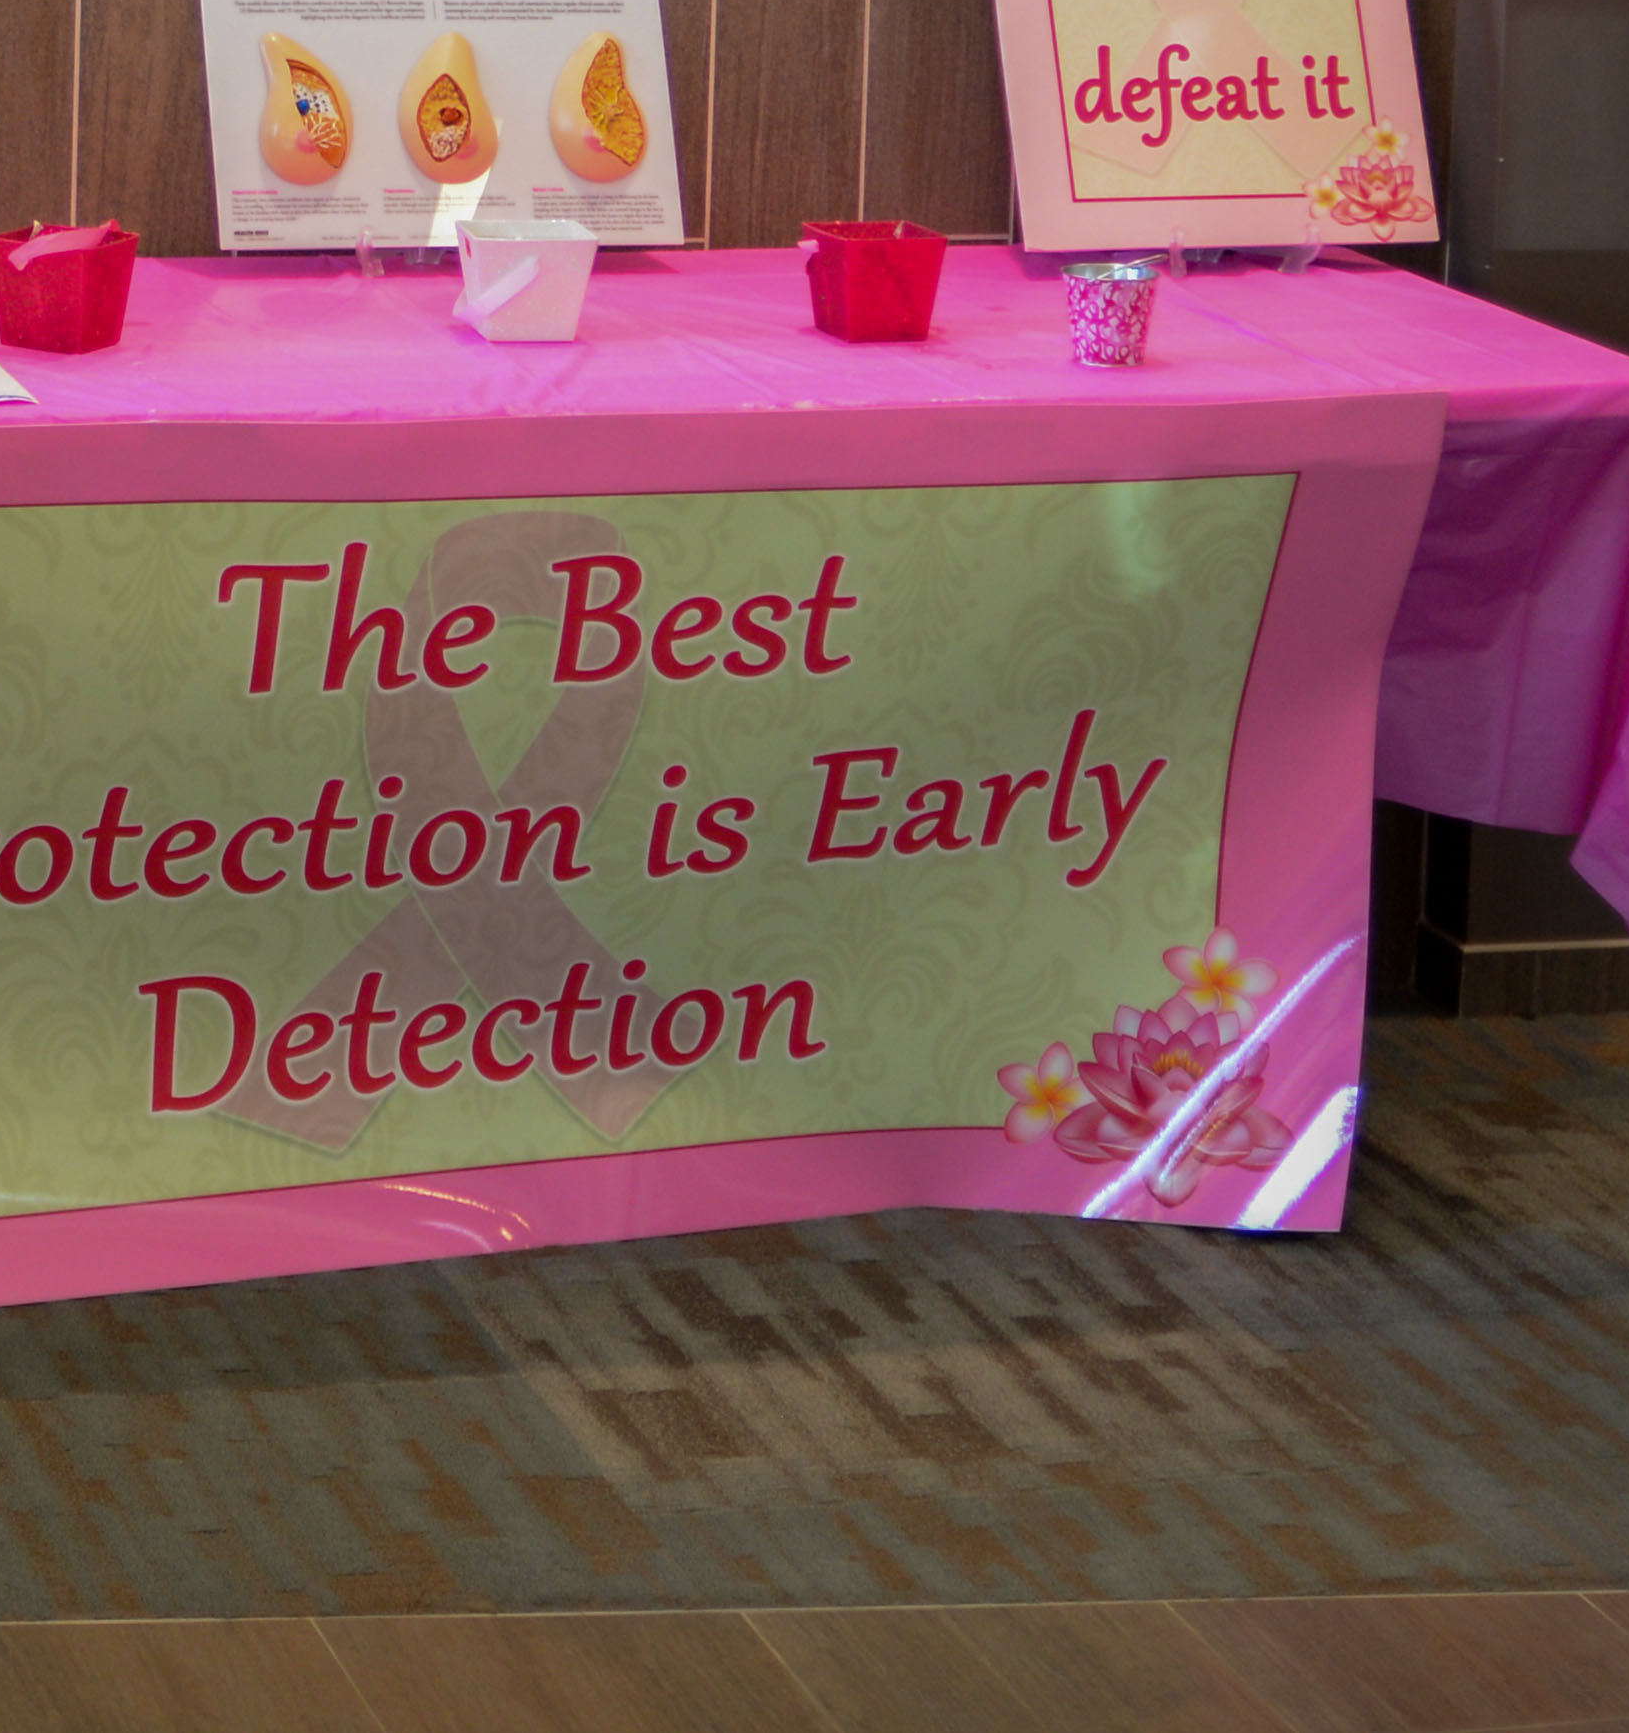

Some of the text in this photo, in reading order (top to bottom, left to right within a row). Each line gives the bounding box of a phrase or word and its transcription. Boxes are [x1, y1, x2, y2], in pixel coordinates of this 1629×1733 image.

[1074, 43, 1355, 148] defeat it
[218, 541, 858, 695] The Best
[645, 763, 755, 879] is
[807, 709, 1168, 890] Early
[139, 958, 826, 1115] Detection
